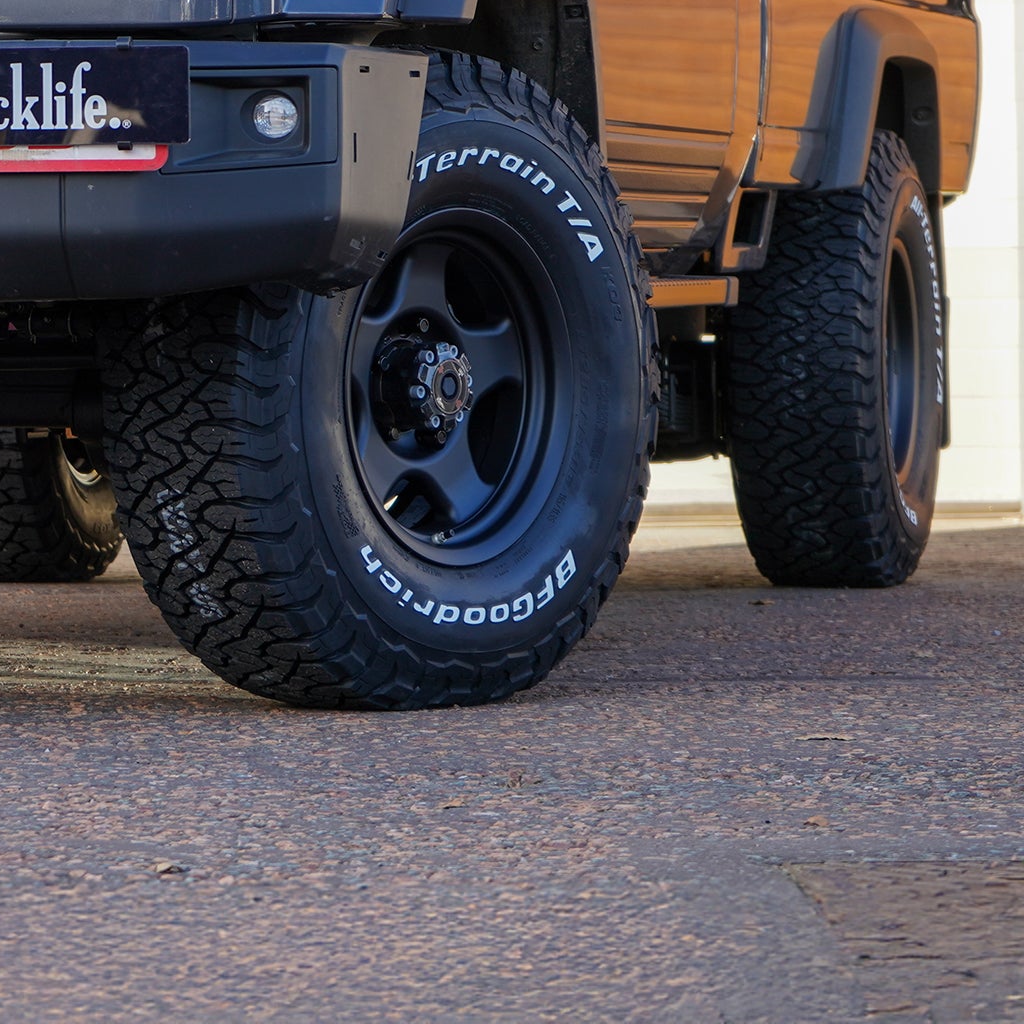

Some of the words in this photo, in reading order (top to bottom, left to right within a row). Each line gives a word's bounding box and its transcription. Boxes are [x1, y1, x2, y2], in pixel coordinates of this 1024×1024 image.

[415, 147, 557, 196] Terrain
[557, 190, 605, 263] T/A
[360, 544, 577, 626] BFGoodrich
